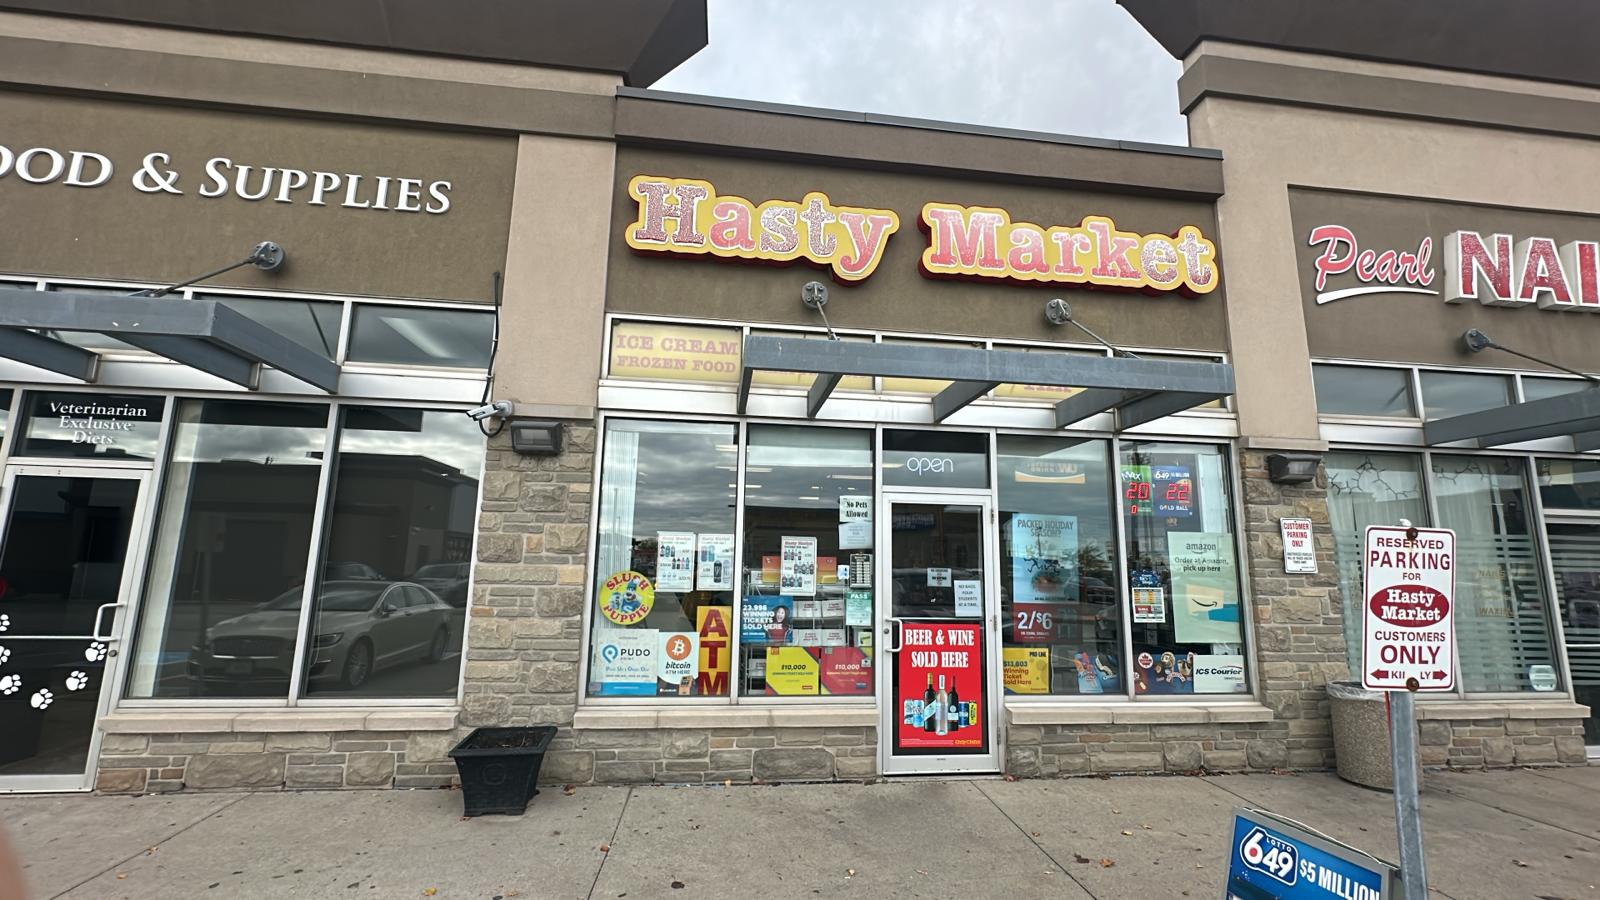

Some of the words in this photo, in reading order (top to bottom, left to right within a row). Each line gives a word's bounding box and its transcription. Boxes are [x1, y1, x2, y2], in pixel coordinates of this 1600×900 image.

[132, 152, 184, 195] &
[199, 157, 453, 214] SUPPLIES
[634, 182, 893, 273] Hasty
[928, 208, 1212, 287] Market
[1309, 224, 1435, 292] Pearl
[616, 334, 655, 350] ICE
[661, 336, 739, 356] CREAM
[616, 354, 688, 371] FROZEN
[692, 357, 737, 374] FOOD
[50, 402, 147, 417] Veterinarian
[59, 415, 132, 431] Exclusive
[72, 430, 114, 444] Diets
[906, 457, 954, 476] open
[1155, 470, 1170, 479] 649
[1126, 482, 1150, 499] 20
[1166, 483, 1189, 500] 22
[846, 510, 868, 518] Allowed
[1287, 531, 1308, 539] PARKING
[1376, 537, 1444, 549] RESERVED
[1183, 564, 1197, 572] pick
[1370, 551, 1450, 570] PARKING
[1402, 572, 1421, 581] FOR
[1386, 588, 1435, 606] Hasty
[603, 604, 649, 622] PUPPIE
[1381, 605, 1441, 621] Market
[905, 629, 933, 645] BEER
[935, 629, 945, 645] &
[947, 629, 975, 646] WINE
[1374, 630, 1446, 642] CUSTOMERS
[620, 648, 651, 656] PUDO
[698, 608, 729, 696] ATM
[911, 651, 938, 668] SOLD
[941, 651, 969, 668] HERE
[1380, 644, 1441, 665] ONLY
[665, 661, 691, 669] bitcoin
[1004, 667, 1029, 675] Winning
[1266, 836, 1292, 852] LOTTO
[1243, 831, 1294, 878] 649
[1299, 858, 1316, 883] $5
